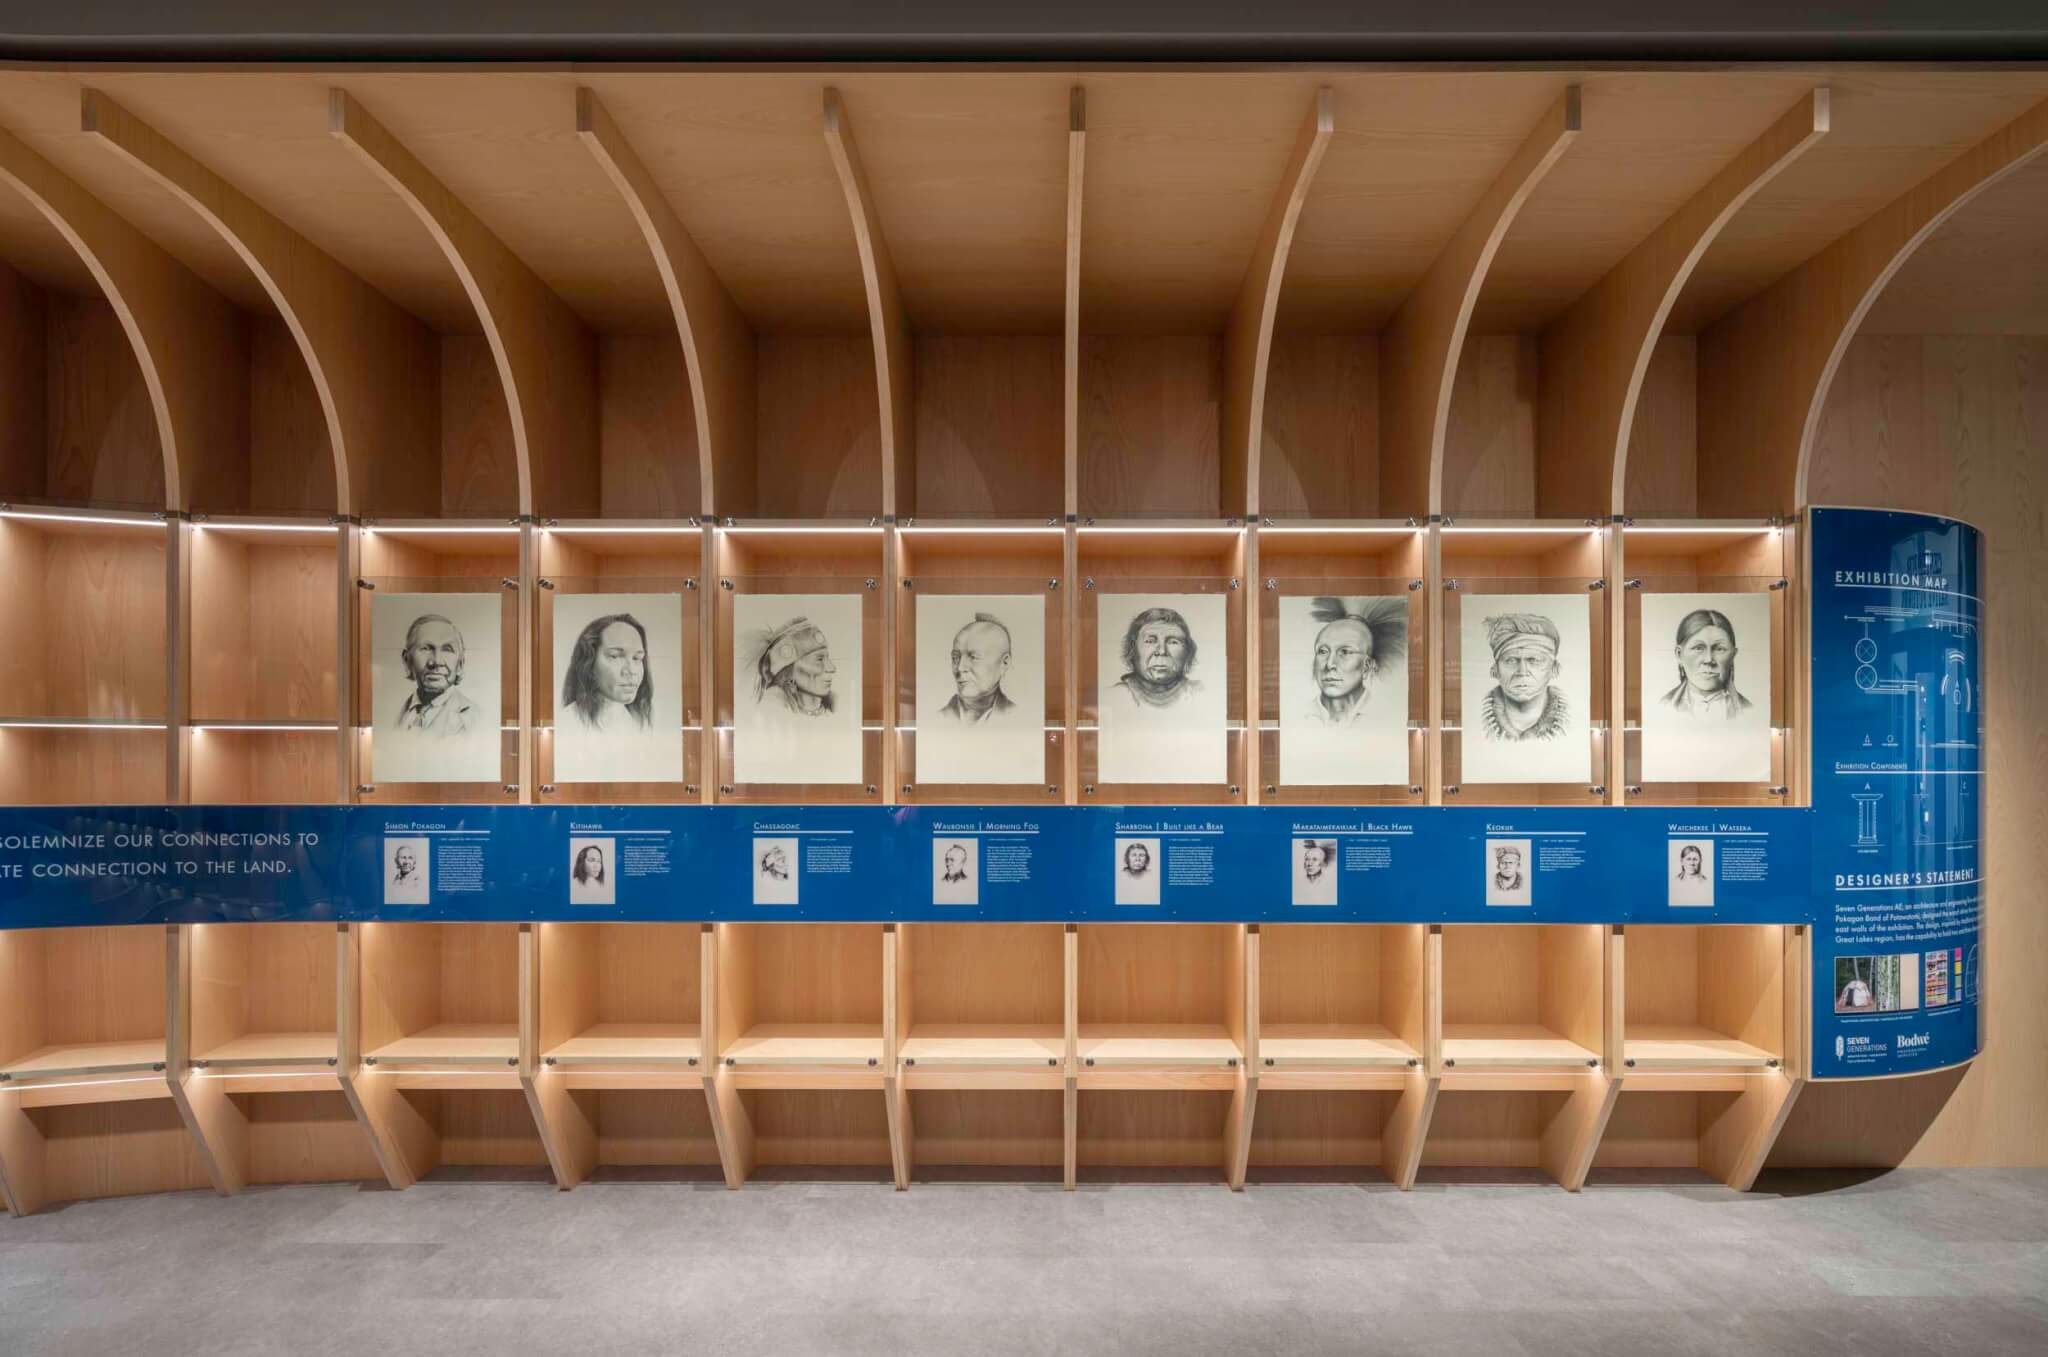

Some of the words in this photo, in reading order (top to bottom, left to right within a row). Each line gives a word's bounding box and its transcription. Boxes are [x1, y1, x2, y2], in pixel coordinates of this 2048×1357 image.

[1835, 571, 1920, 586] EXHIBITION
[1924, 577, 1948, 590] MAP
[114, 833, 154, 848] OUR
[162, 832, 291, 846] CONNECTIONS
[298, 832, 318, 846] TO
[0, 864, 23, 878] TE
[32, 861, 167, 878] CONNECTION
[175, 861, 198, 875] TO
[206, 860, 236, 874] THE
[243, 860, 291, 874] LAND.
[1926, 868, 1974, 883] STATEMENT
[1835, 904, 1856, 912] Seven
[1835, 914, 1864, 924] Pokagon
[1865, 913, 1882, 922] Band
[1835, 935, 1855, 944] Great
[1847, 1036, 1870, 1045] SEVEN
[1897, 1031, 1930, 1049] Bodwé
[1847, 1043, 1888, 1053] GENERATIONS
